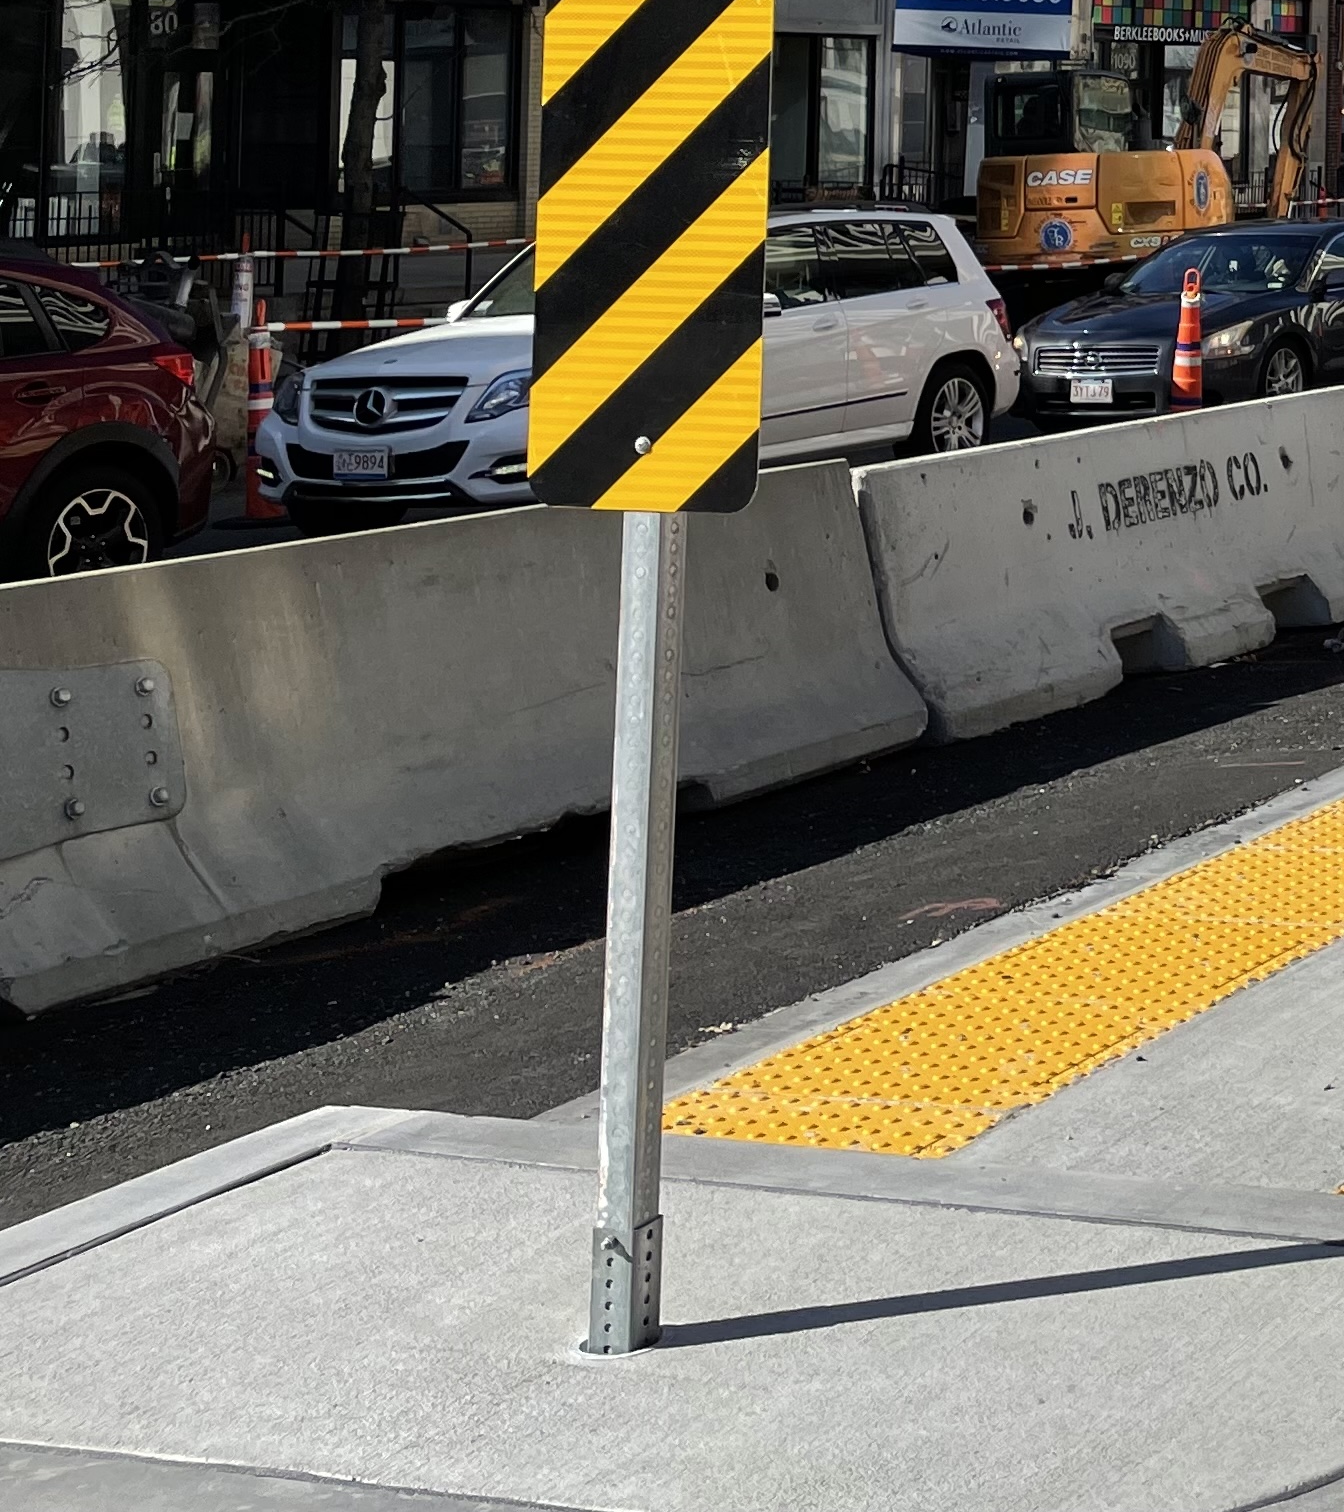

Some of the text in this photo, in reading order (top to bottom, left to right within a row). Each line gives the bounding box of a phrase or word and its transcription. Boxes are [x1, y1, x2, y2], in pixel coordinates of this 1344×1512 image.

[959, 18, 1022, 37] Atlantic
[1113, 25, 1211, 44] BERKLEEBOOKS+MUS
[1026, 169, 1093, 187] CASE
[1068, 451, 1269, 540] J. DERENZO CO.
